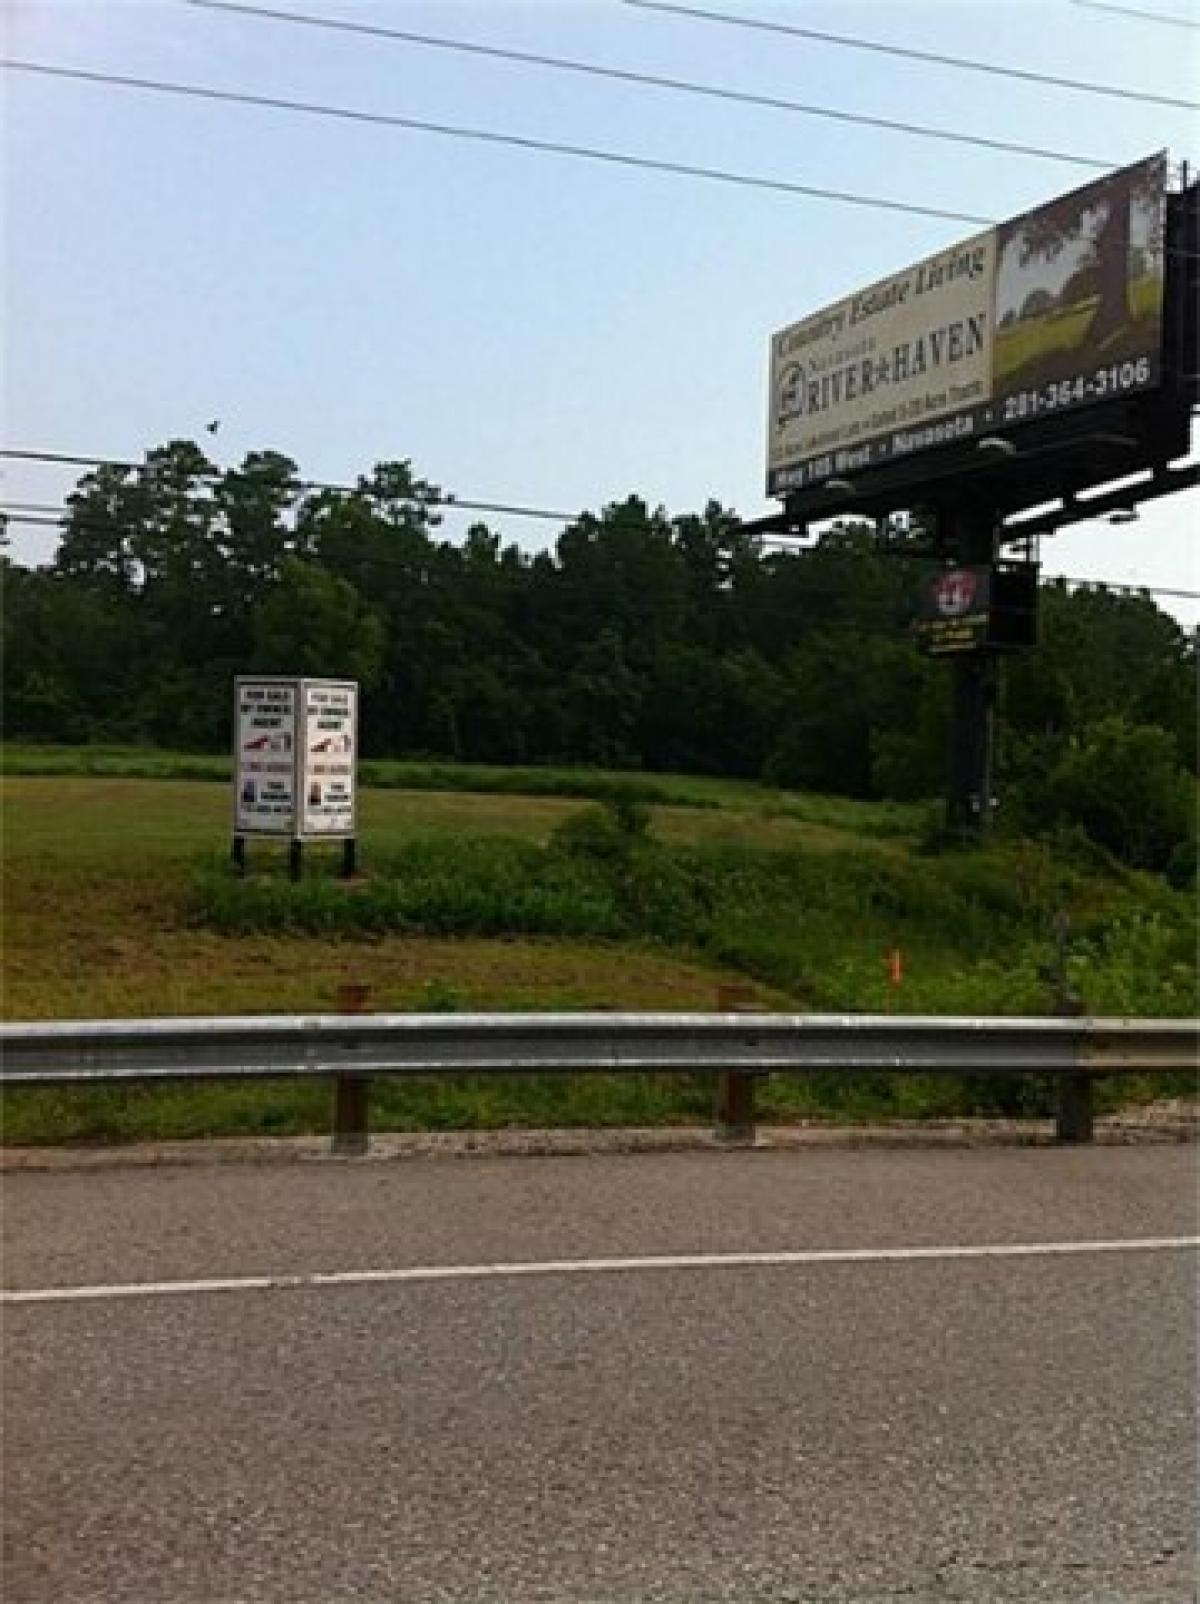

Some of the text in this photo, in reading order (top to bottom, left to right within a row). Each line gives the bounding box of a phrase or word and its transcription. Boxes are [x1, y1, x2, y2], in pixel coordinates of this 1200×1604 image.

[915, 247, 984, 294] Living
[809, 314, 986, 415] RIVER HAVEN
